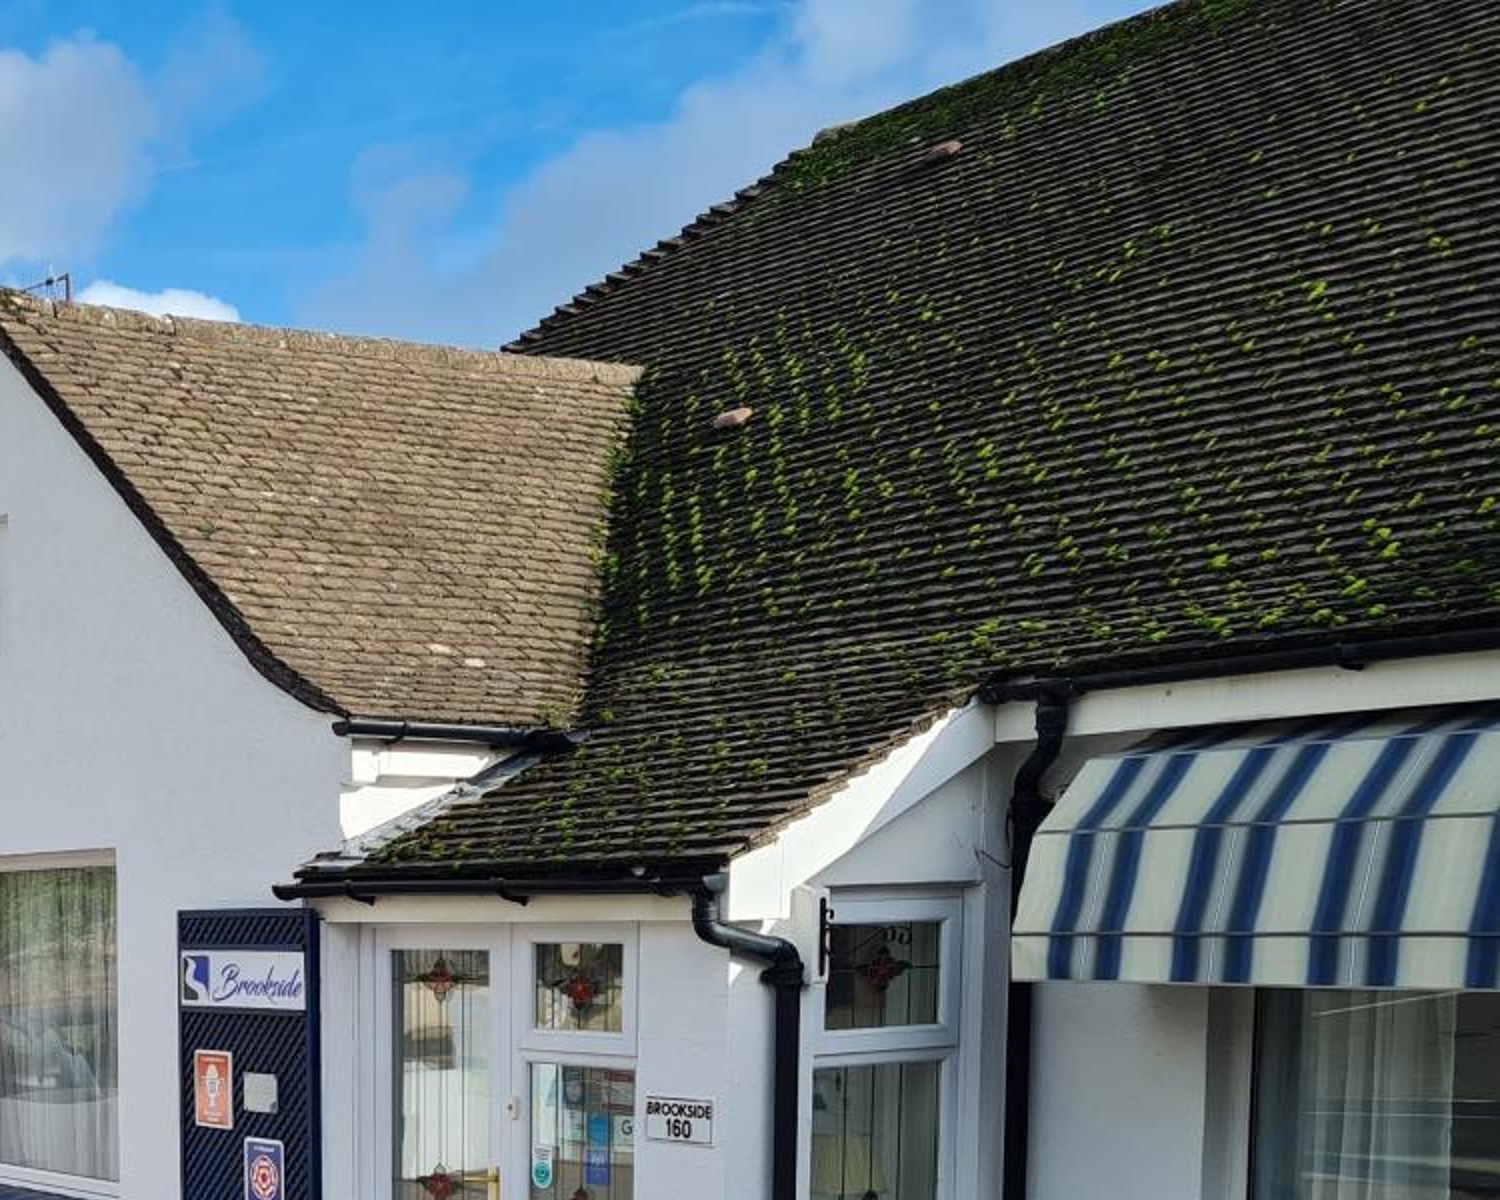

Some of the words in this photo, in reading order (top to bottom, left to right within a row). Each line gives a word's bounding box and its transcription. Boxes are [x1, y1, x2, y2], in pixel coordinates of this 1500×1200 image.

[212, 963, 302, 1005] Brookside
[646, 1101, 712, 1120] BROOKSIDE
[666, 1118, 691, 1138] 160
